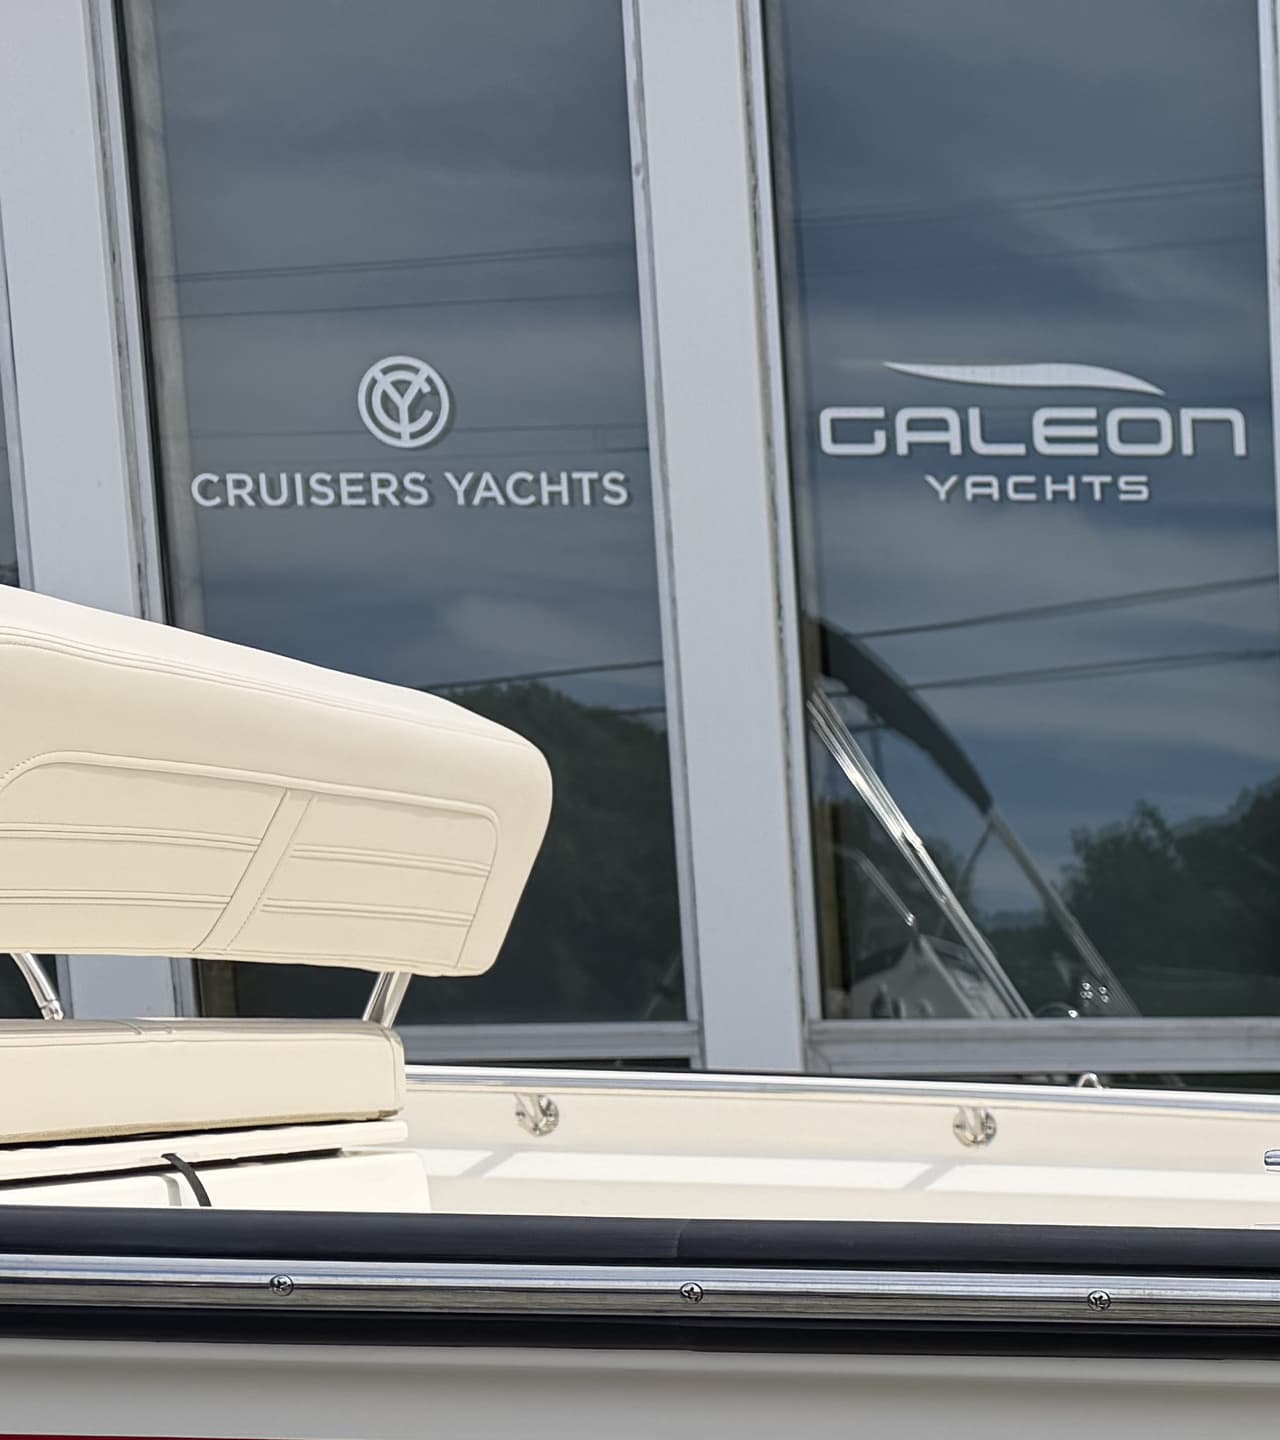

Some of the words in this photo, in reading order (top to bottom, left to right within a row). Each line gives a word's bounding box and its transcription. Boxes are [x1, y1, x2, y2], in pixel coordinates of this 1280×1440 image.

[819, 407, 1247, 456] GALEON
[191, 472, 430, 507] CRUISERS
[444, 471, 628, 506] YACHTS
[925, 475, 1150, 500] YACHTS
